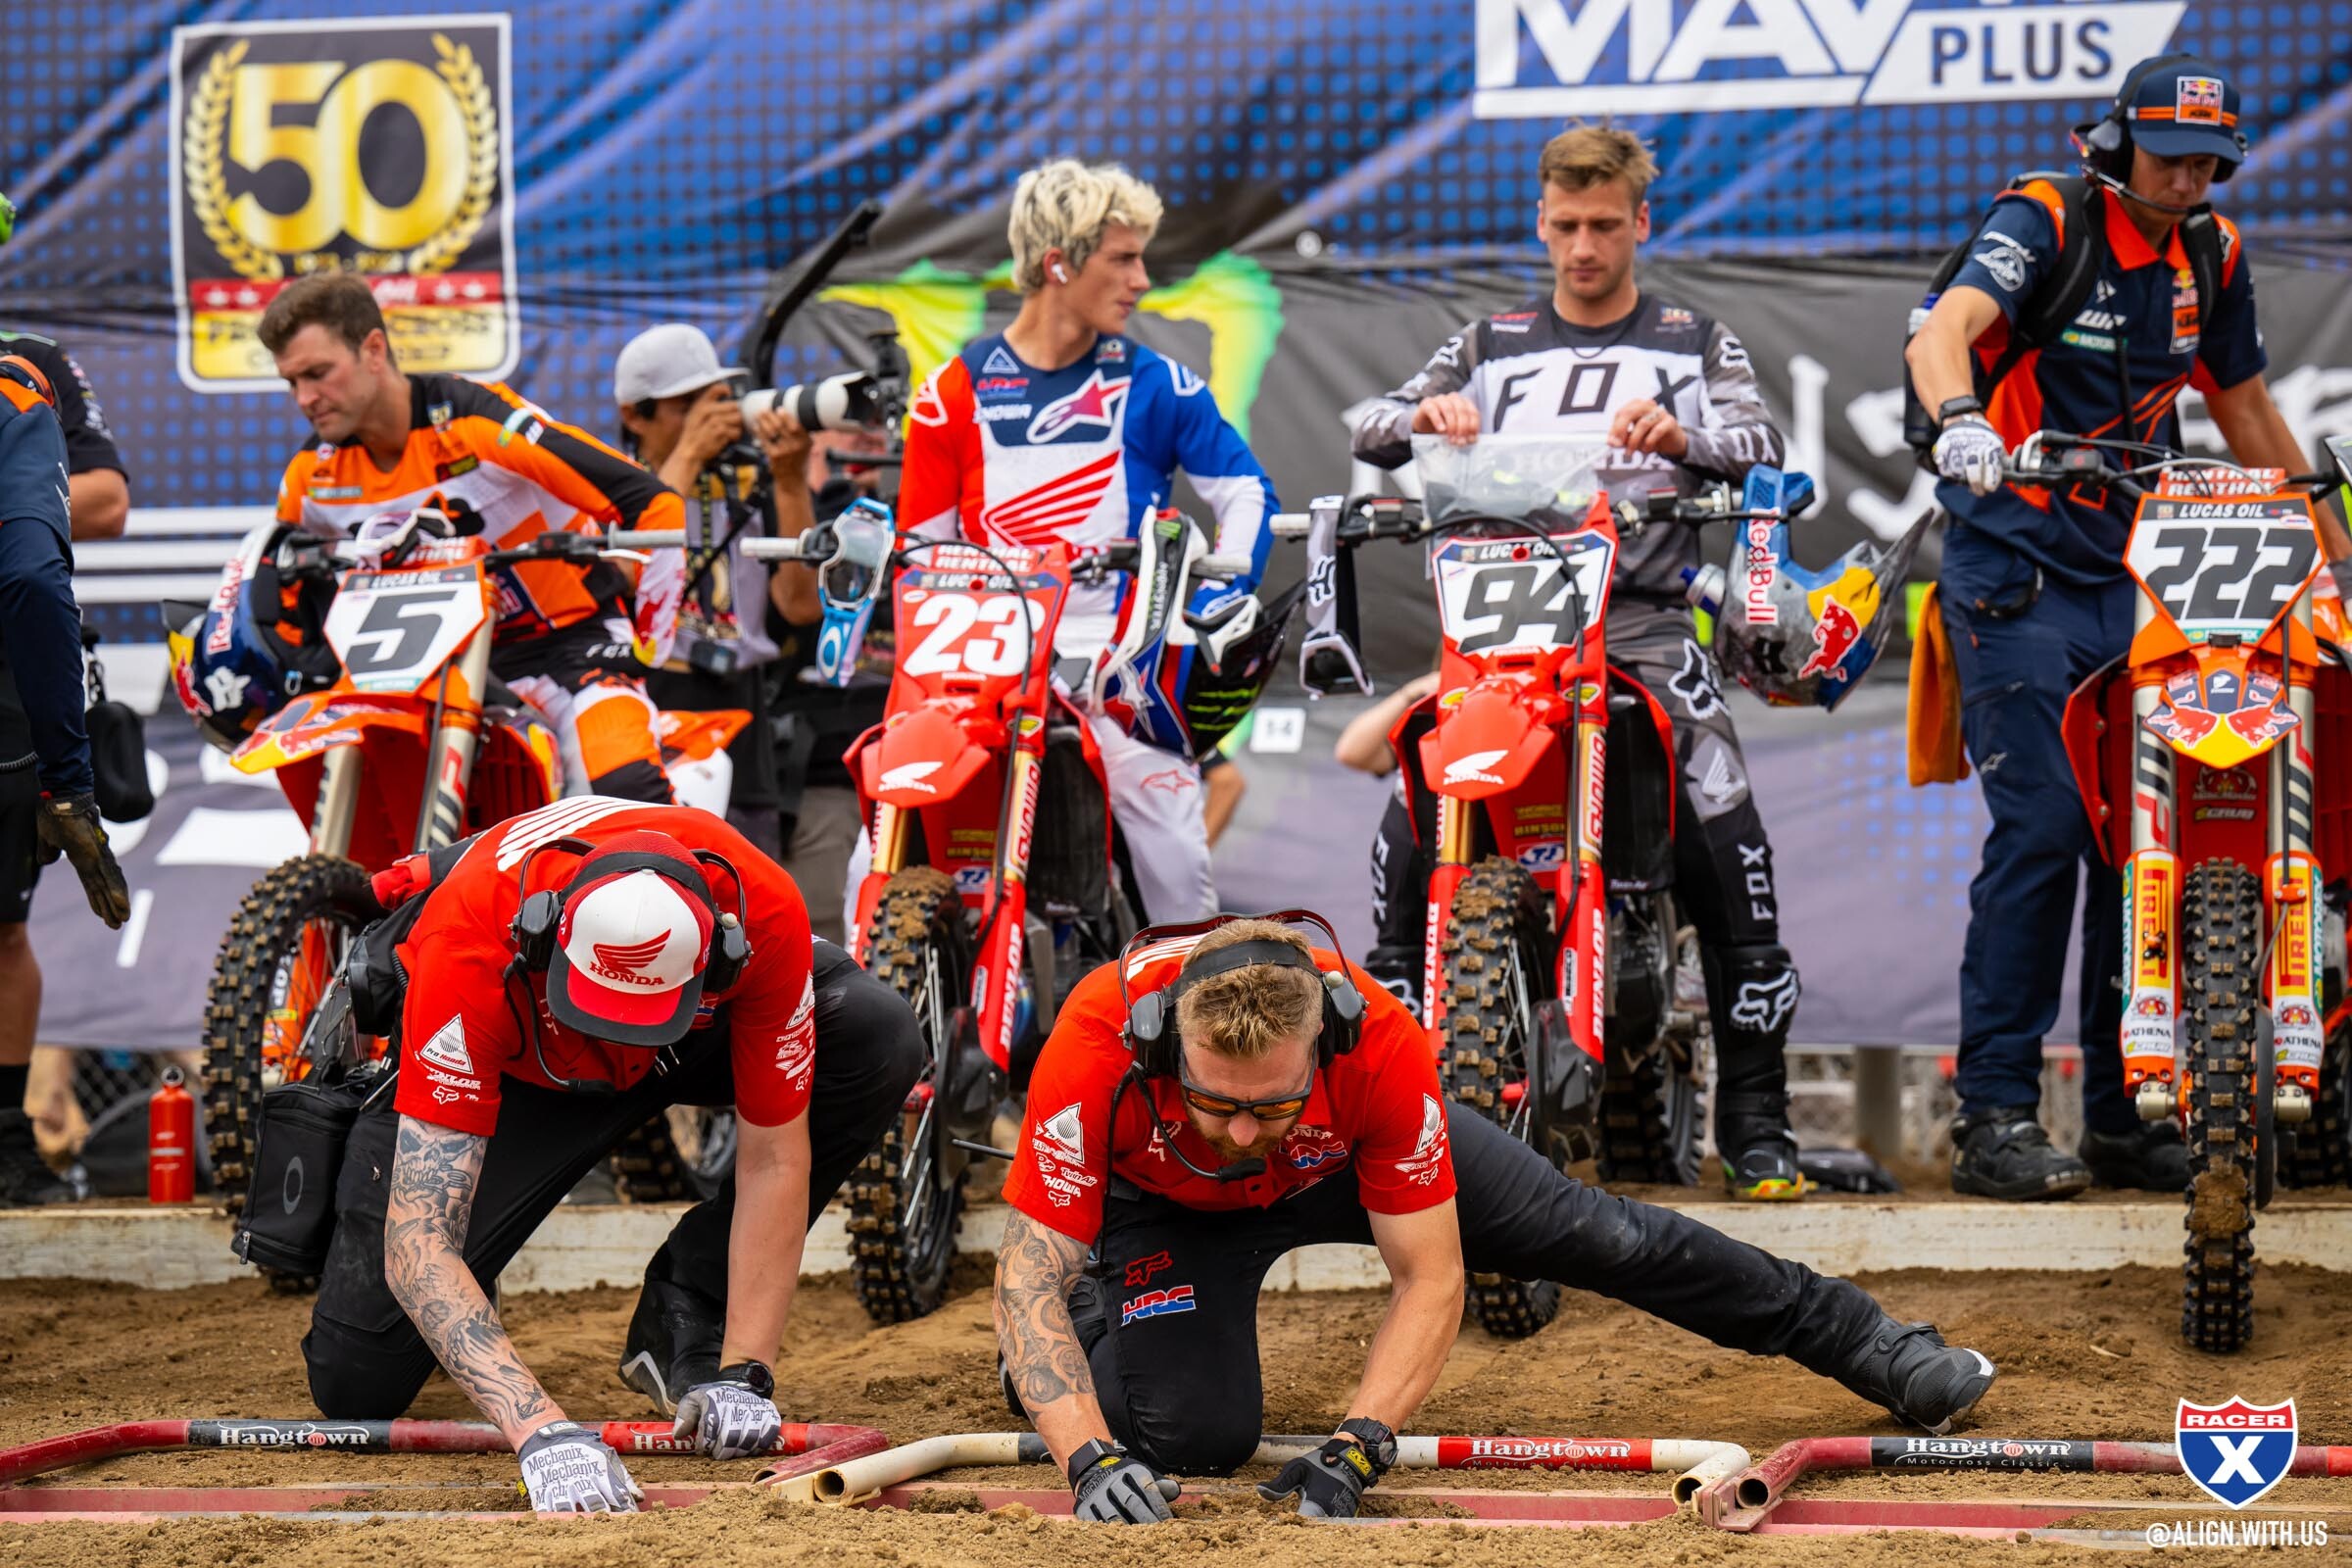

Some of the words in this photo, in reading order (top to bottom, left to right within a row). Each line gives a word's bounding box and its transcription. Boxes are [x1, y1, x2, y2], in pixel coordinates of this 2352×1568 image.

[1932, 21, 2114, 84] PLUS
[222, 59, 470, 254] 50
[1494, 362, 1700, 433] FOX
[2180, 503, 2234, 518] LUCAS
[2237, 503, 2265, 518] OIL
[2145, 527, 2319, 620] 222
[1459, 565, 1591, 655] 94
[345, 590, 459, 675] 5
[903, 594, 1046, 678] 23
[1443, 772, 1505, 786] HONDA
[1738, 844, 1774, 921] FOX
[590, 960, 665, 986] HONDA
[1121, 1285, 1197, 1327] HRC
[527, 1445, 585, 1475] Mechanix
[1471, 1439, 1630, 1458] Hangtown
[1905, 1438, 2071, 1457] Hangtown
[1907, 1457, 1991, 1466] Motocross
[2000, 1458, 2065, 1468] Classic
[540, 1459, 603, 1488] Mechanix
